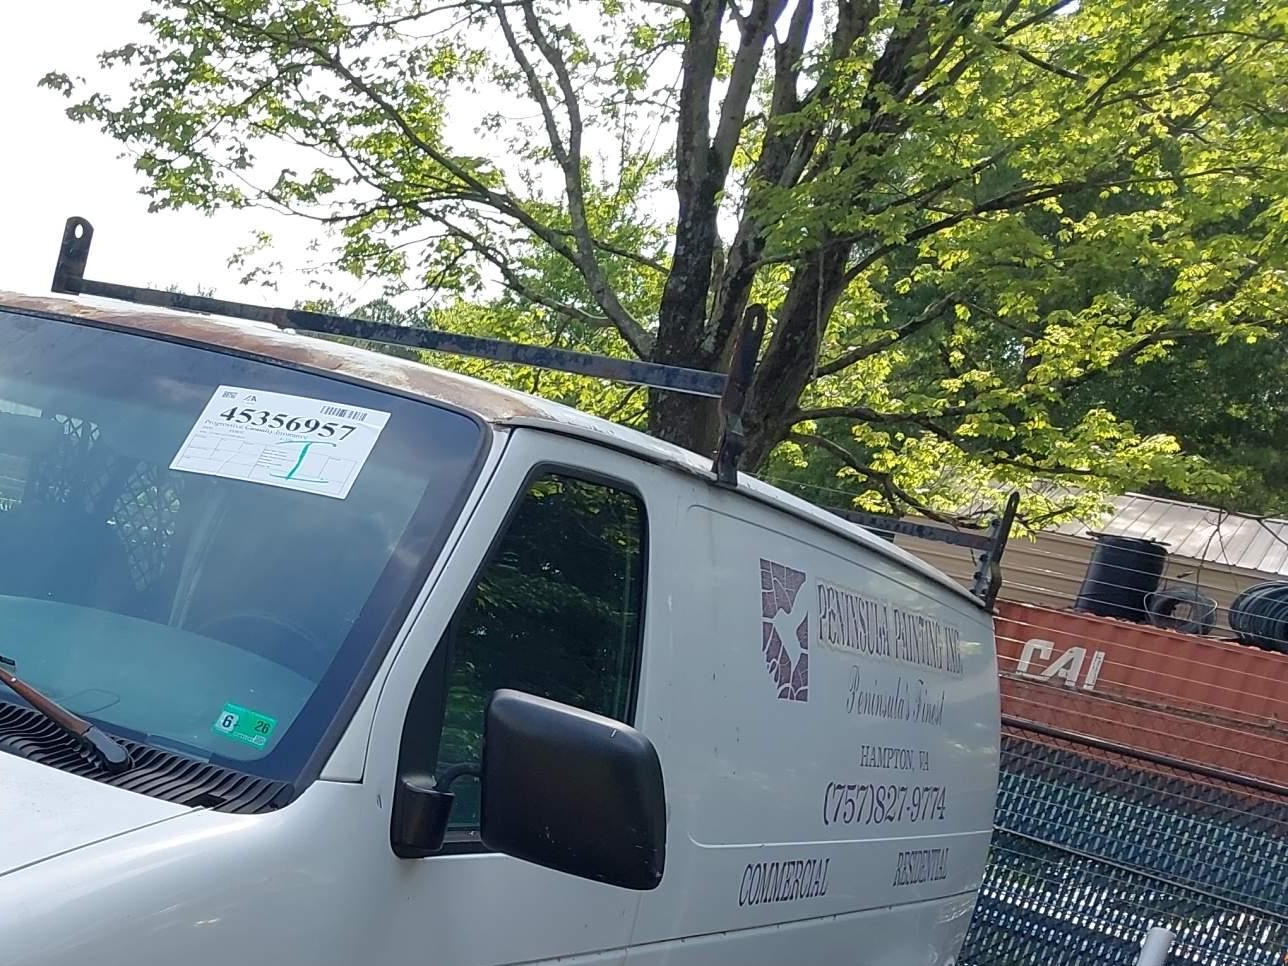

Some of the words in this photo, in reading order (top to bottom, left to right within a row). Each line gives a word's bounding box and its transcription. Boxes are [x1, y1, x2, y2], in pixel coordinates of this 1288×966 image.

[220, 406, 357, 442] 45356957
[817, 584, 891, 657] PENINSULA
[894, 608, 943, 670] PAINTING
[1016, 638, 1106, 690] CAI
[846, 664, 910, 721] Peninsula's
[911, 678, 945, 727] Finest
[222, 714, 234, 729] 6
[255, 721, 271, 734] 26
[859, 744, 915, 772] HAMPTON,
[919, 750, 930, 772] VA
[823, 781, 947, 826] (757)827-9774
[738, 857, 831, 907] COMMERCIAL
[892, 847, 950, 887] RESIDENTIAL
